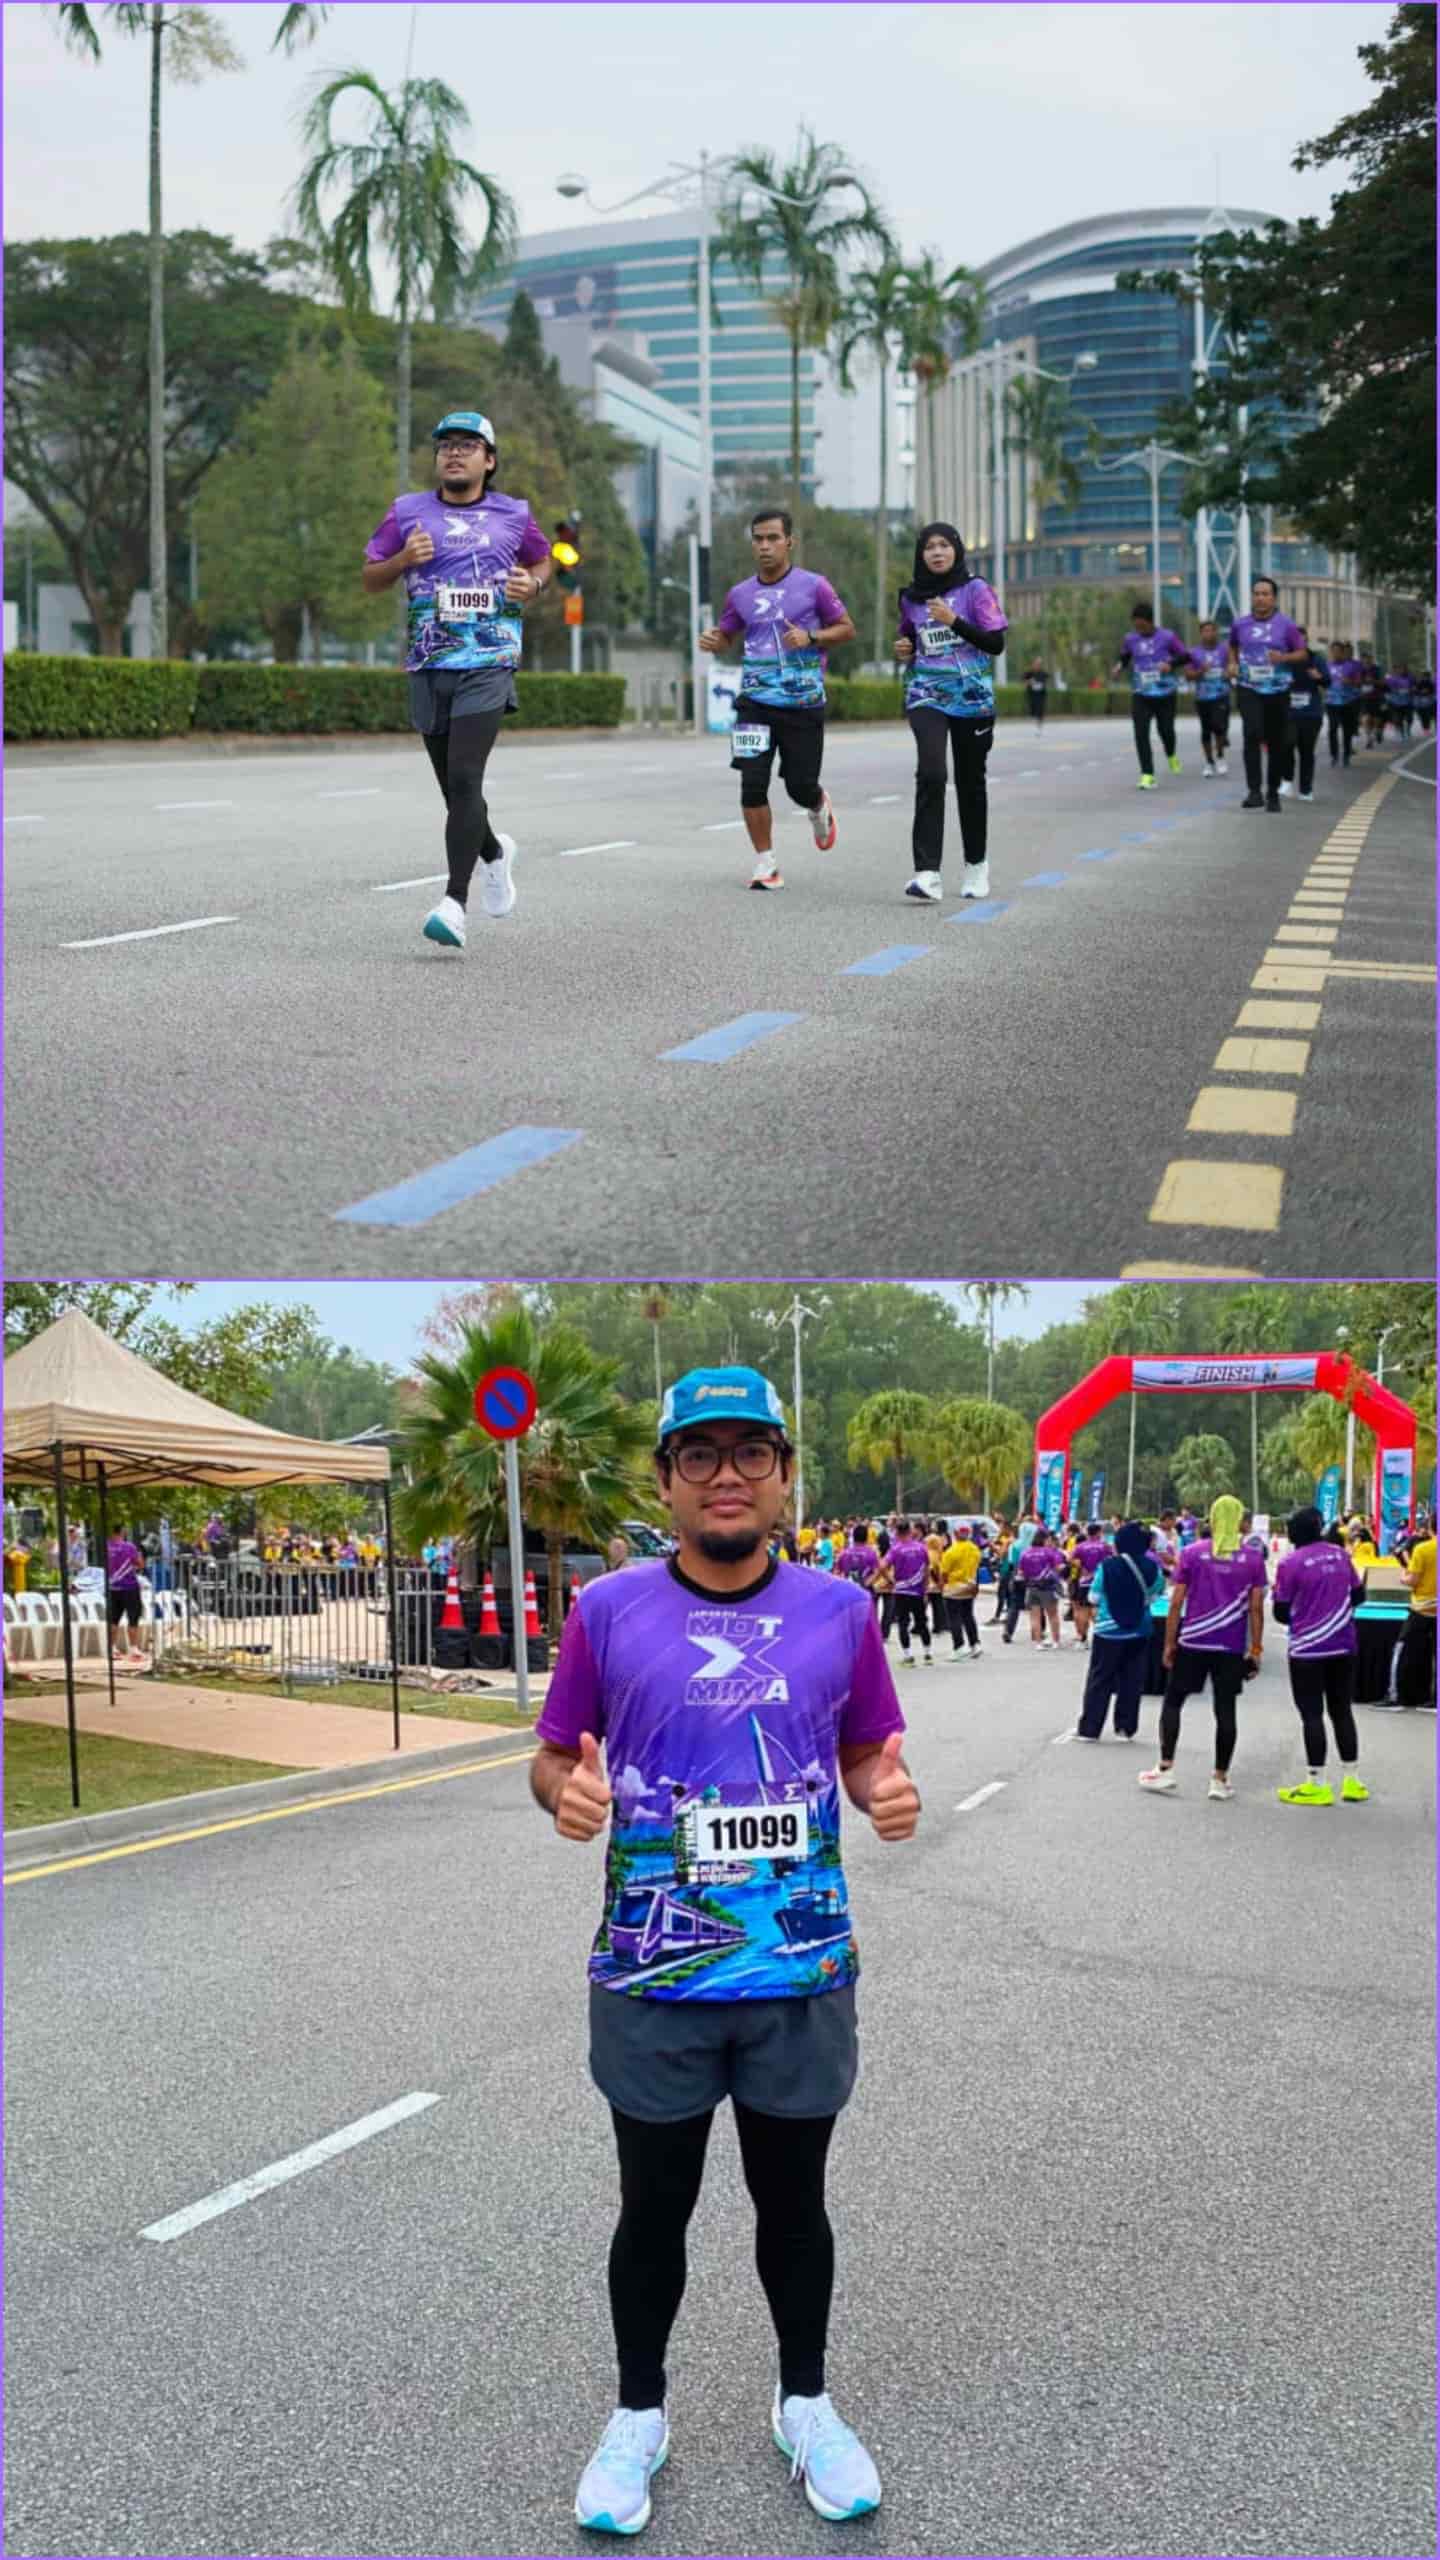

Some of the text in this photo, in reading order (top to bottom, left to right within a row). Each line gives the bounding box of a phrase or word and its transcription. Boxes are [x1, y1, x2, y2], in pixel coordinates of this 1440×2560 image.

[450, 592, 490, 609] 11099
[1197, 1366, 1256, 1382] FINISH
[687, 1615, 784, 1638] MOT
[684, 1677, 791, 1705] MIMA
[707, 1813, 799, 1851] 11099
